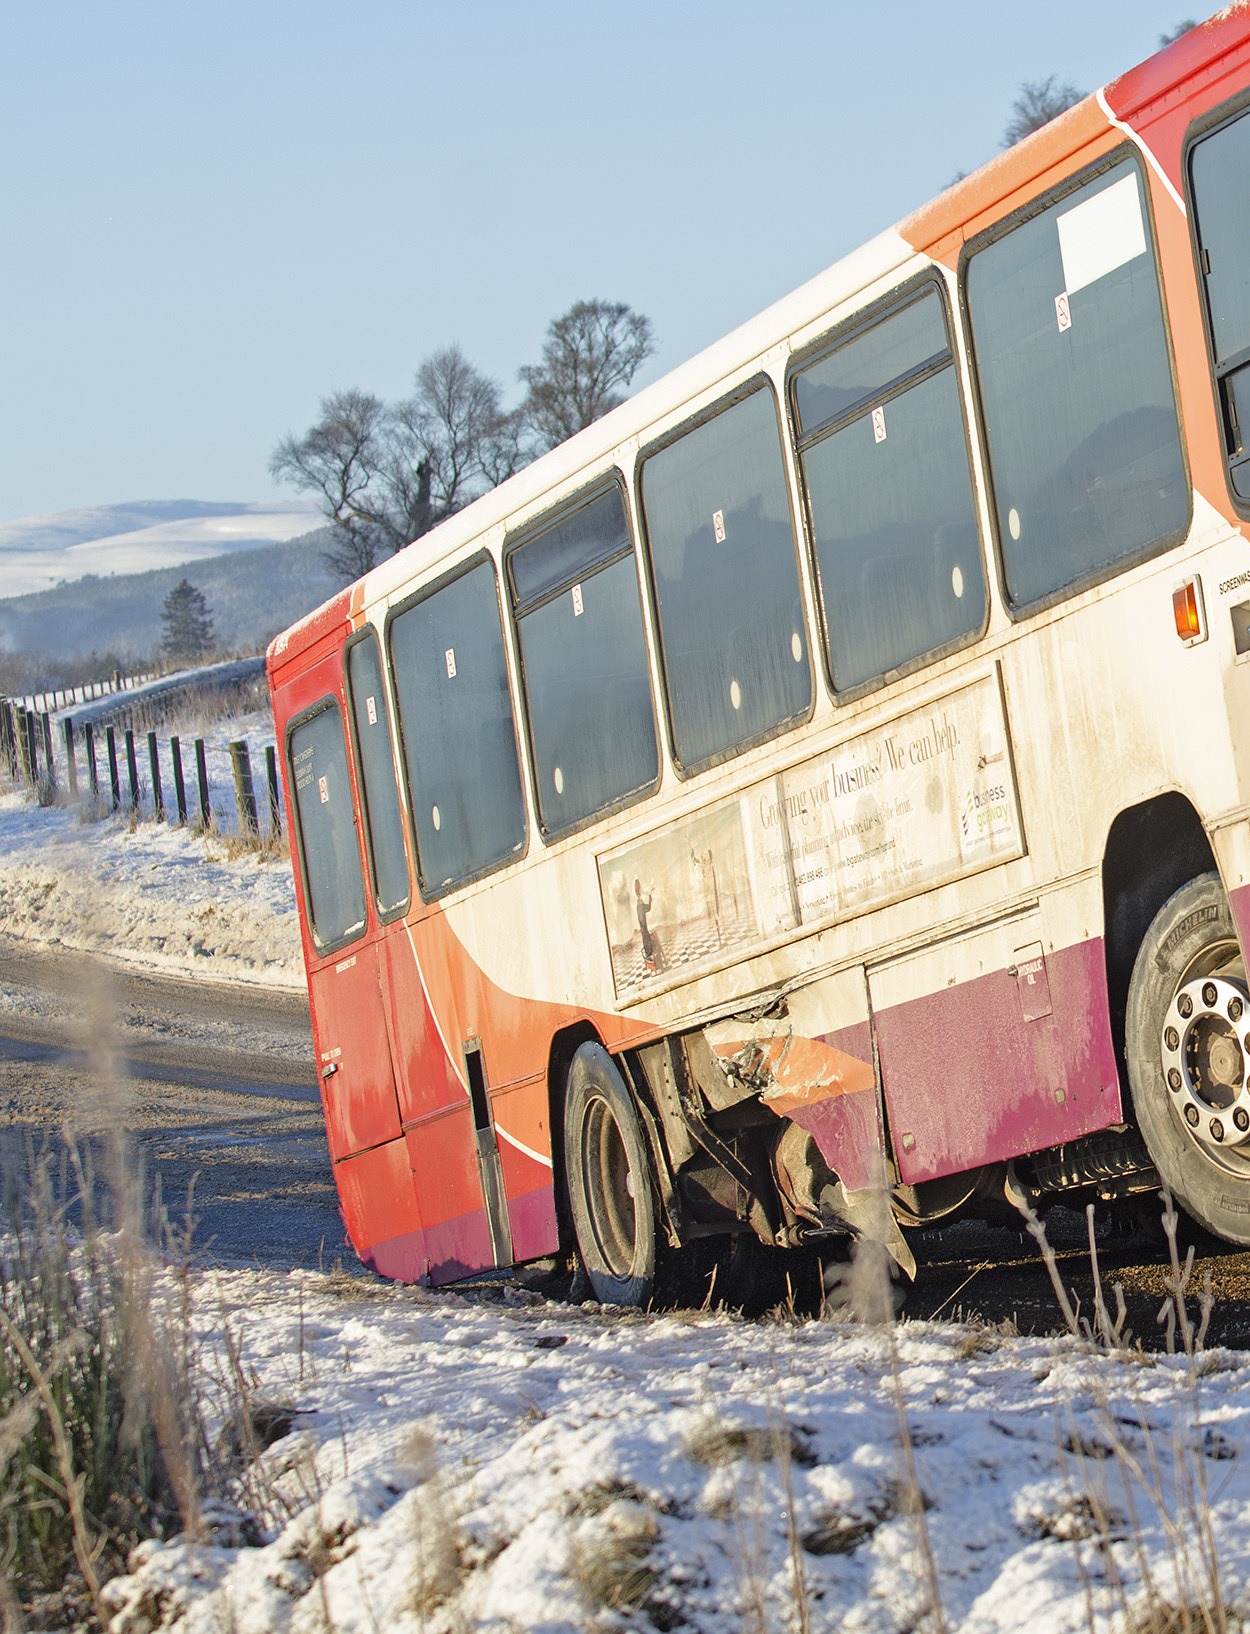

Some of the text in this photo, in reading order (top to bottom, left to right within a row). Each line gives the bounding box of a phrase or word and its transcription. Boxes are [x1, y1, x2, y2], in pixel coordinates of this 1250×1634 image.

[885, 734, 905, 772] We
[910, 734, 931, 766] can
[931, 712, 961, 761] help.
[973, 785, 1006, 808] bsness
[1166, 905, 1218, 952] MICHELIN
